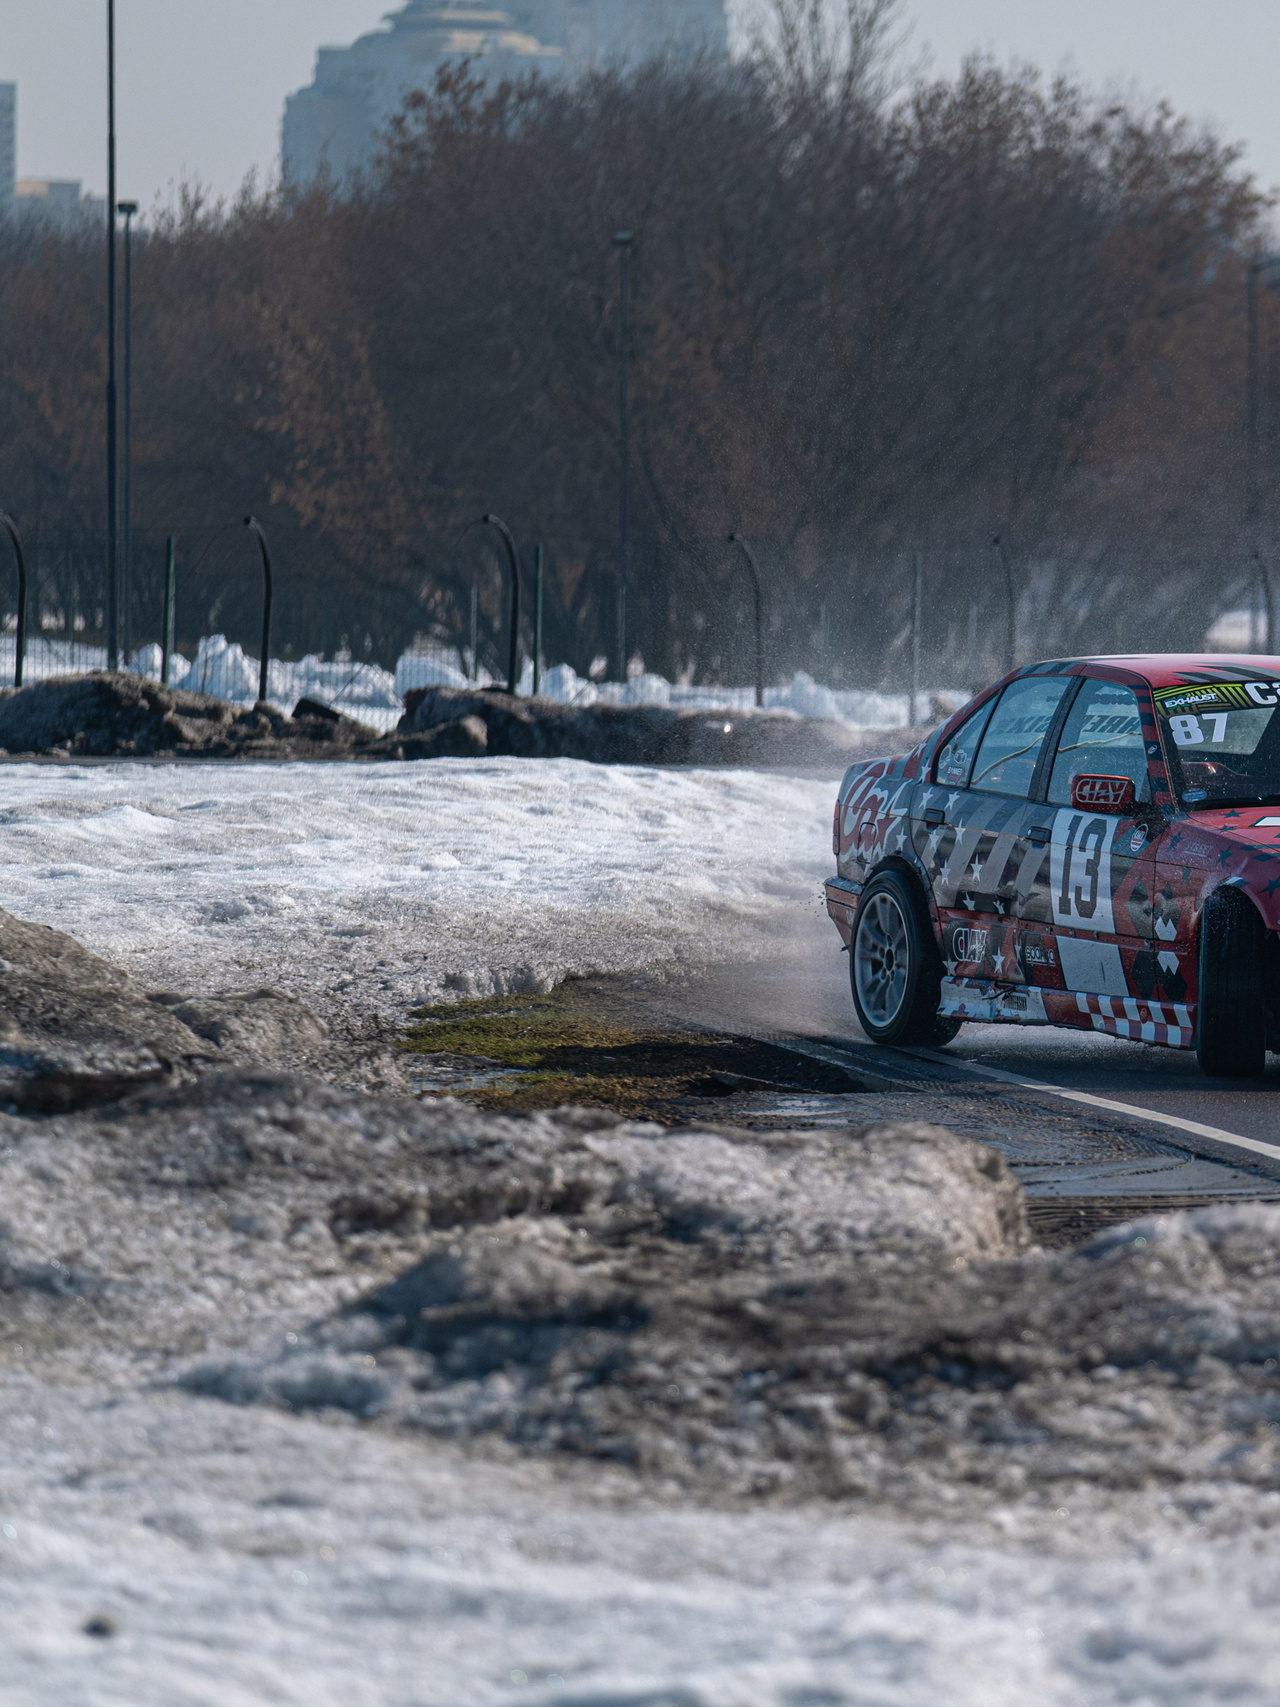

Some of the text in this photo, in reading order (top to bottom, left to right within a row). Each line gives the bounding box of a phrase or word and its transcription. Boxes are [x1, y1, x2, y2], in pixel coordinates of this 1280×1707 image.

[1164, 692, 1217, 708] EXHAUST
[1168, 713, 1229, 746] 87
[1058, 814, 1108, 919] 13
